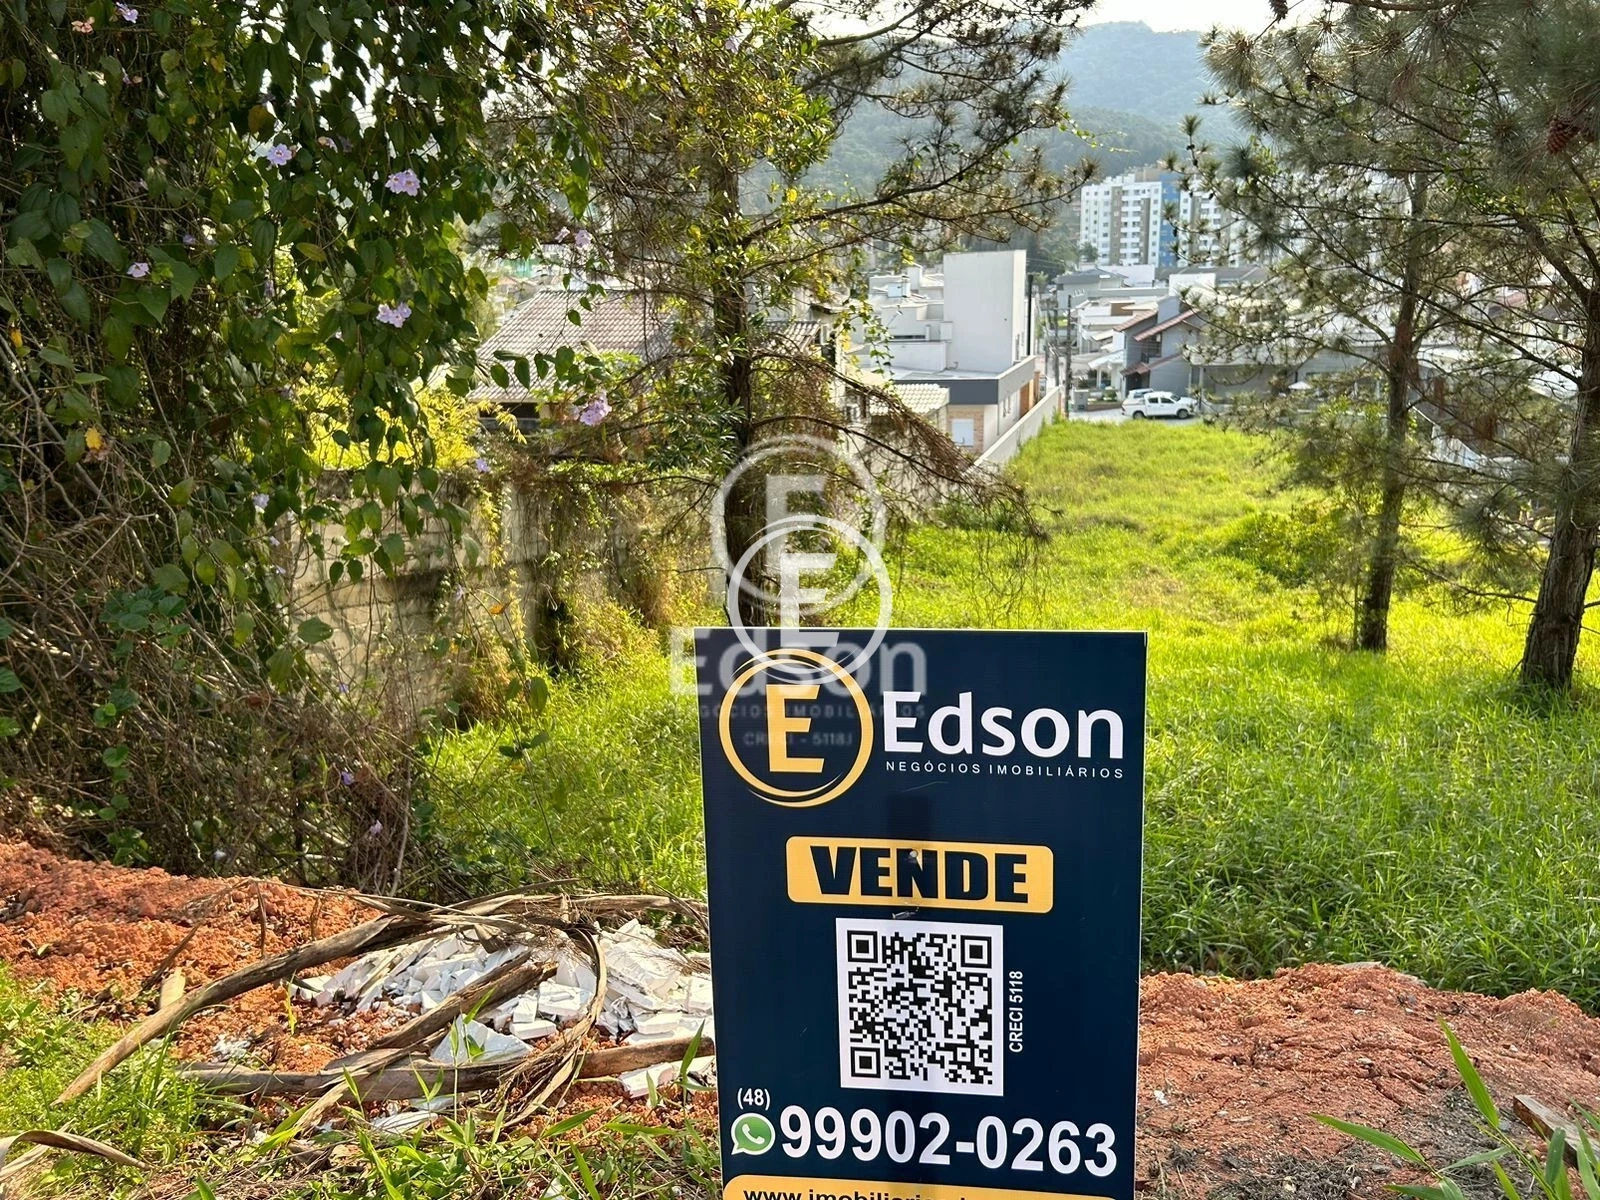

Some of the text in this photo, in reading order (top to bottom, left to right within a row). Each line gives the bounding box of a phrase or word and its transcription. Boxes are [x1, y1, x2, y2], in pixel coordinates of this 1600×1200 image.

[766, 684, 825, 774] E
[883, 691, 1124, 759] Edson
[886, 760, 1123, 779] NEGÓCIOS IMOBILIÁRIOS
[810, 845, 1029, 904] VENDE
[1008, 970, 1023, 1053] CRECI 5118
[737, 1087, 771, 1110] (48)
[780, 1104, 1117, 1177] 99902-0263
